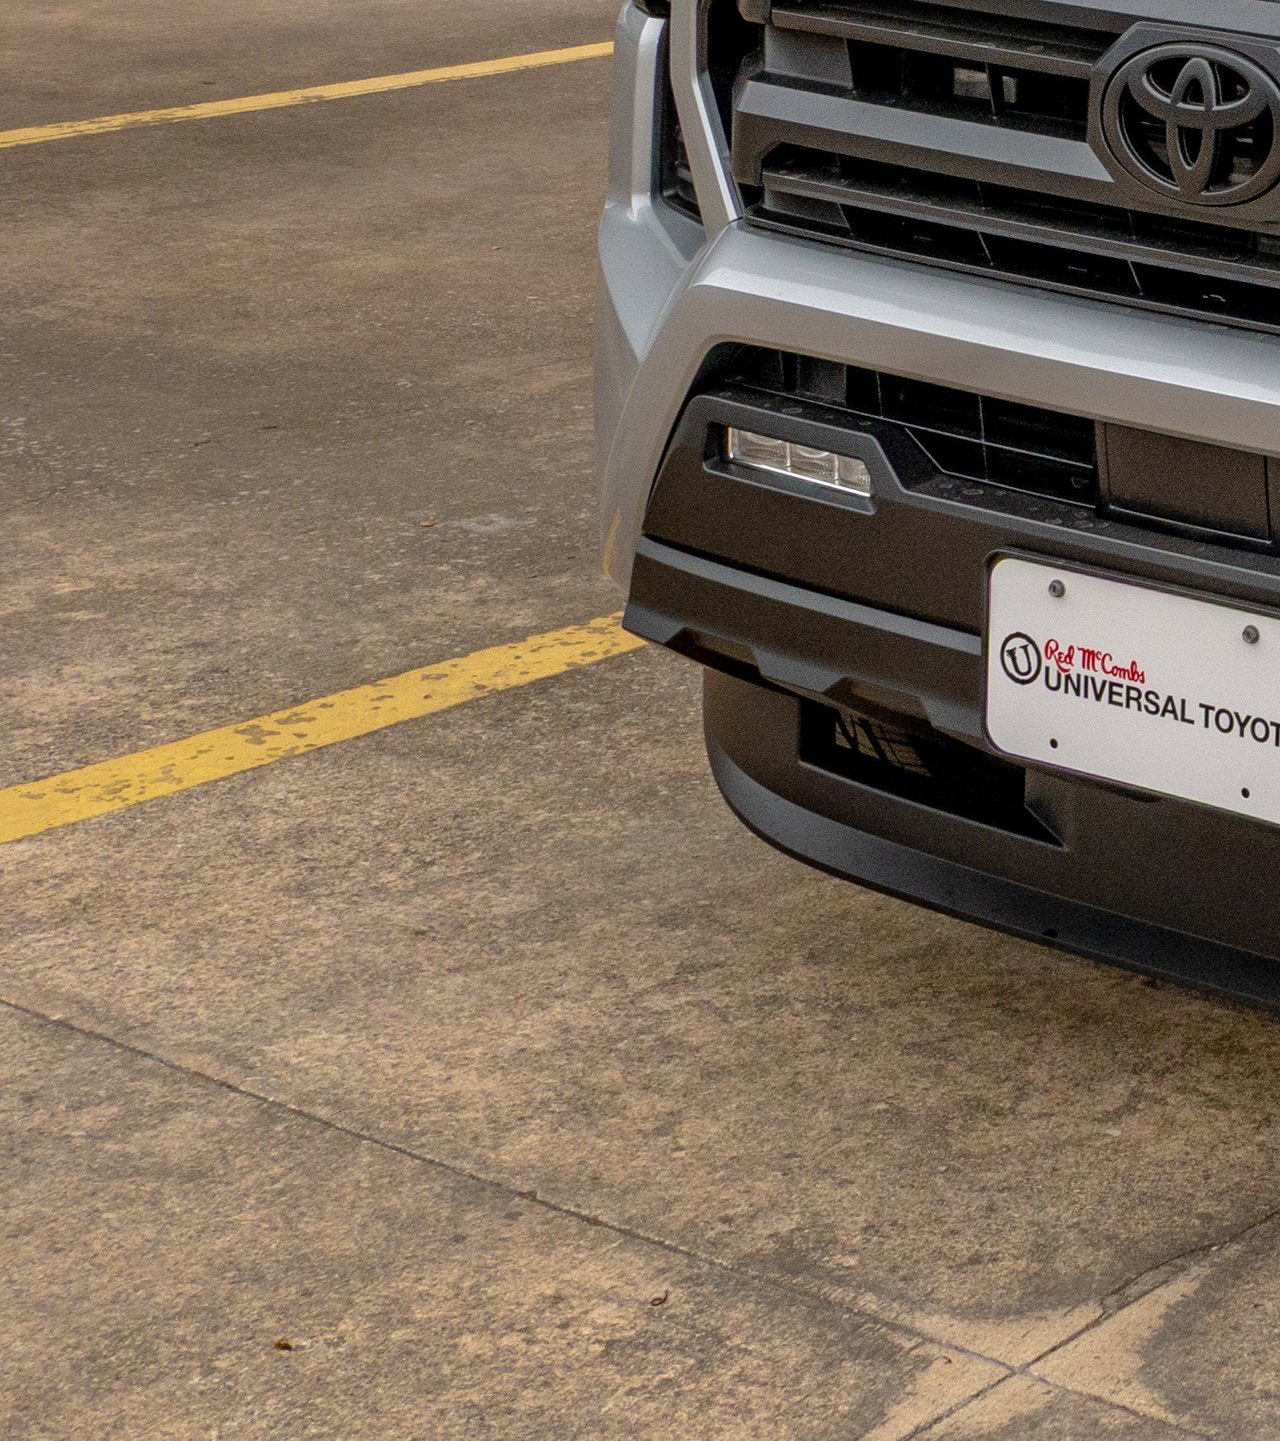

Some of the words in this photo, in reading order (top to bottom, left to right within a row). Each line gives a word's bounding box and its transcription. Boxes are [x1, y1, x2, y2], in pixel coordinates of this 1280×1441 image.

[1045, 638, 1075, 673] Red
[1078, 646, 1146, 684] McCombs
[1044, 665, 1195, 725] UNIVERSAL
